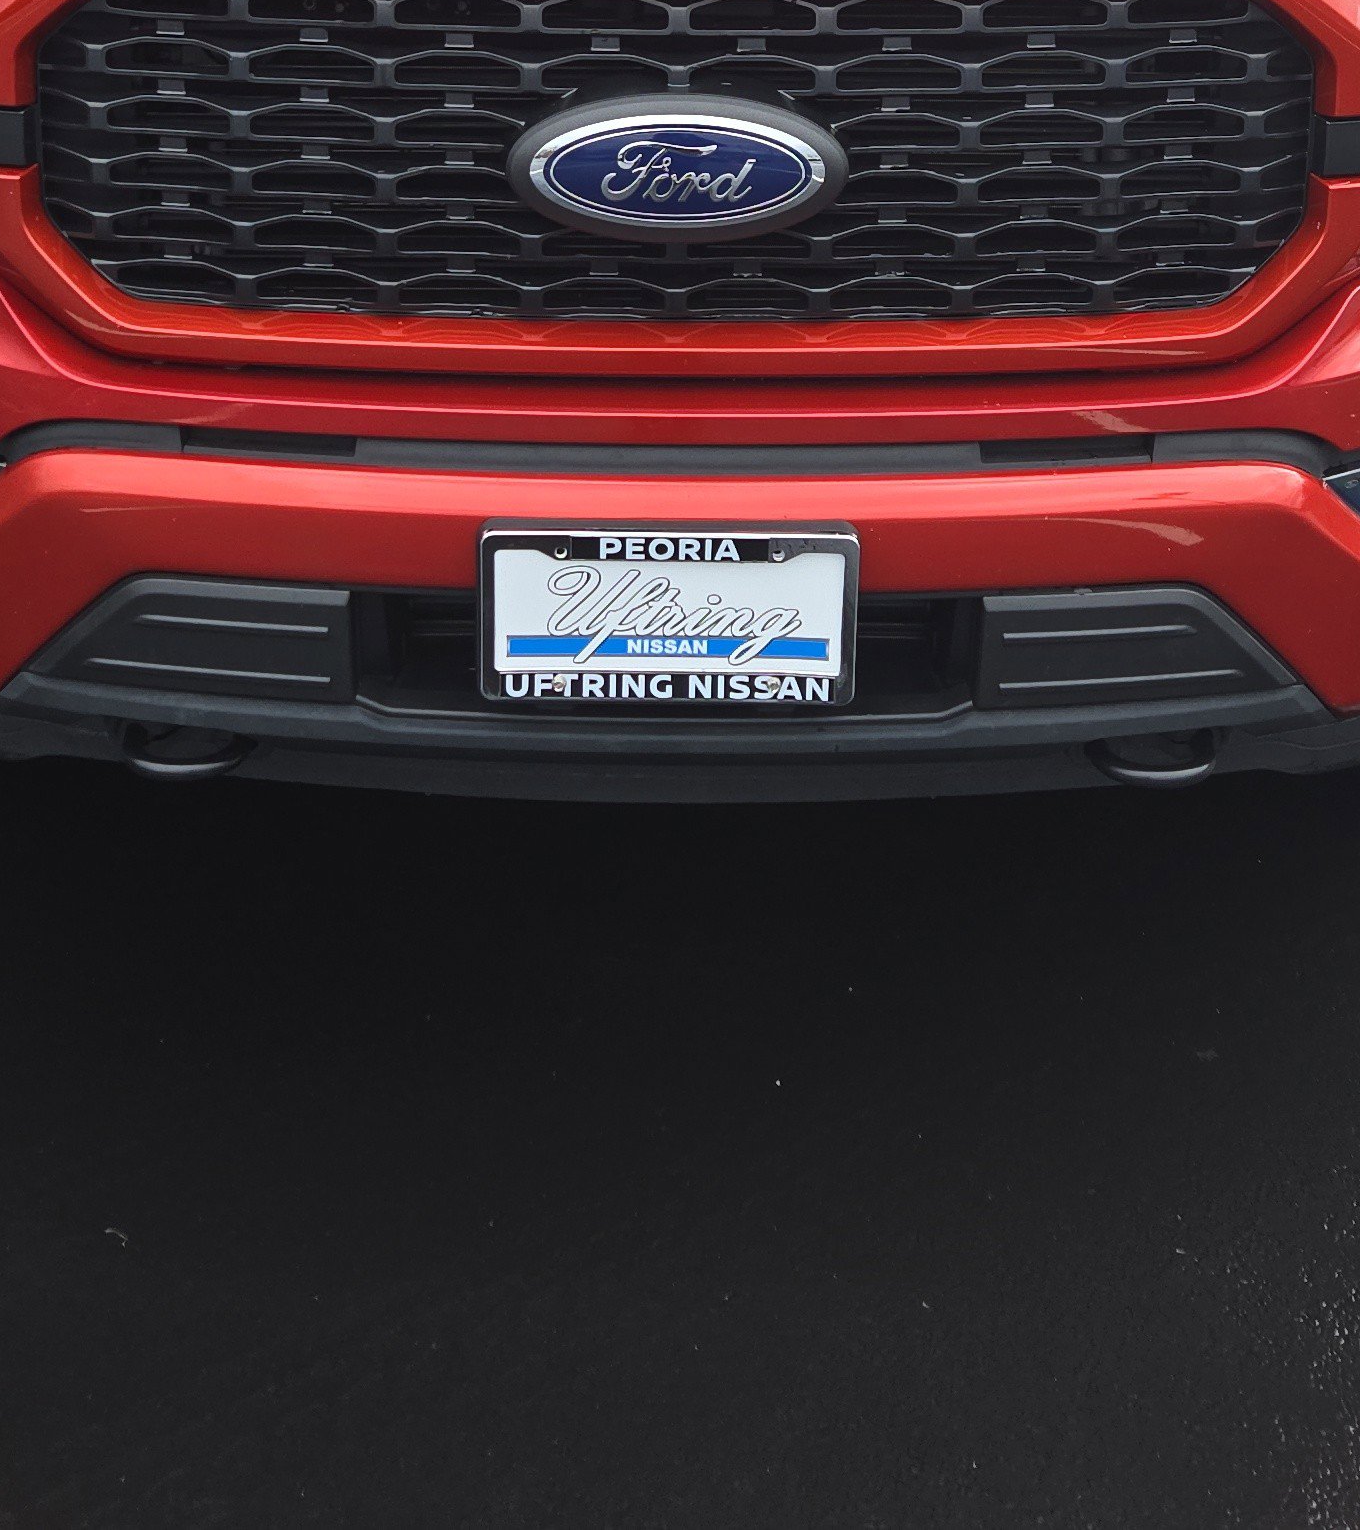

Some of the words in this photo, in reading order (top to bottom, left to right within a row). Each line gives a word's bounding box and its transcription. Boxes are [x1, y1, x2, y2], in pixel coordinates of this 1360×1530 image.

[601, 140, 757, 202] Ford
[599, 537, 741, 561] PEORIA
[546, 565, 803, 665] Uftring
[627, 640, 708, 655] NISSAN
[689, 675, 830, 702] NISSAN
